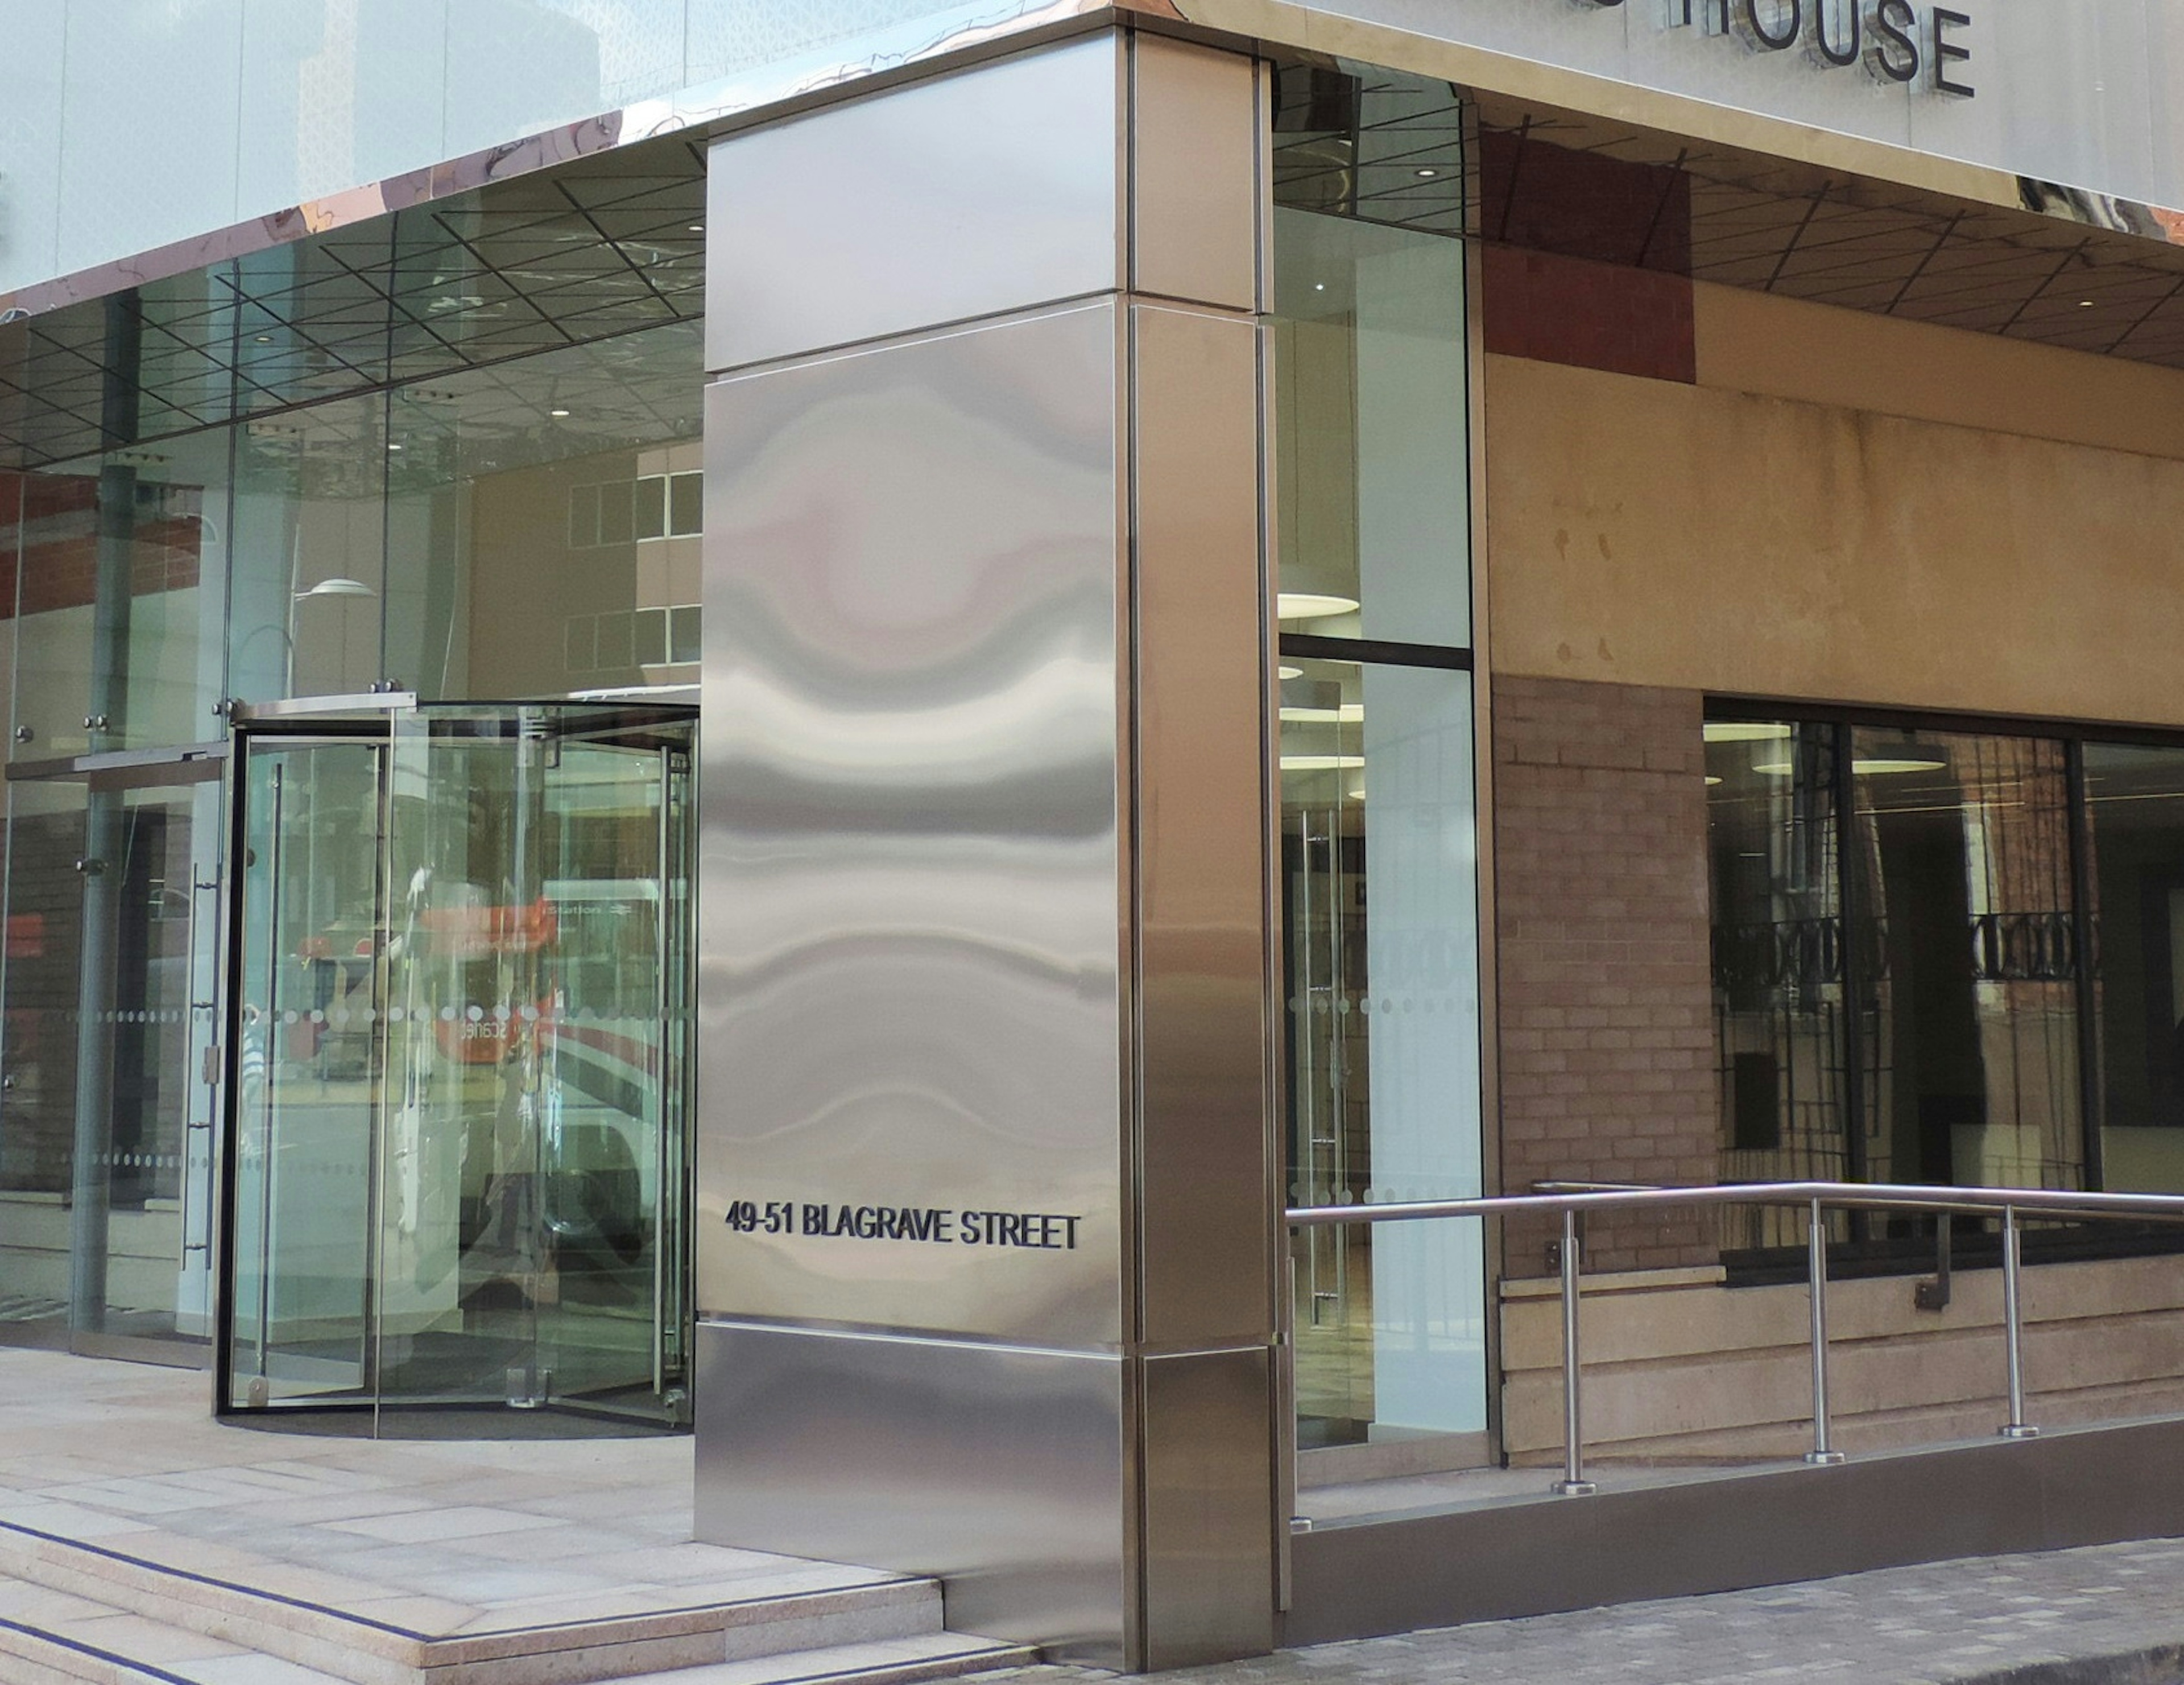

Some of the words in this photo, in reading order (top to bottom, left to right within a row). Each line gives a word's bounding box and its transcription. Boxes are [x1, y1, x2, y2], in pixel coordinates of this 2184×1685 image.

[725, 1200, 793, 1233] 49-51
[802, 1203, 953, 1242] BLAGRAVE
[960, 1209, 1081, 1249] STREET
